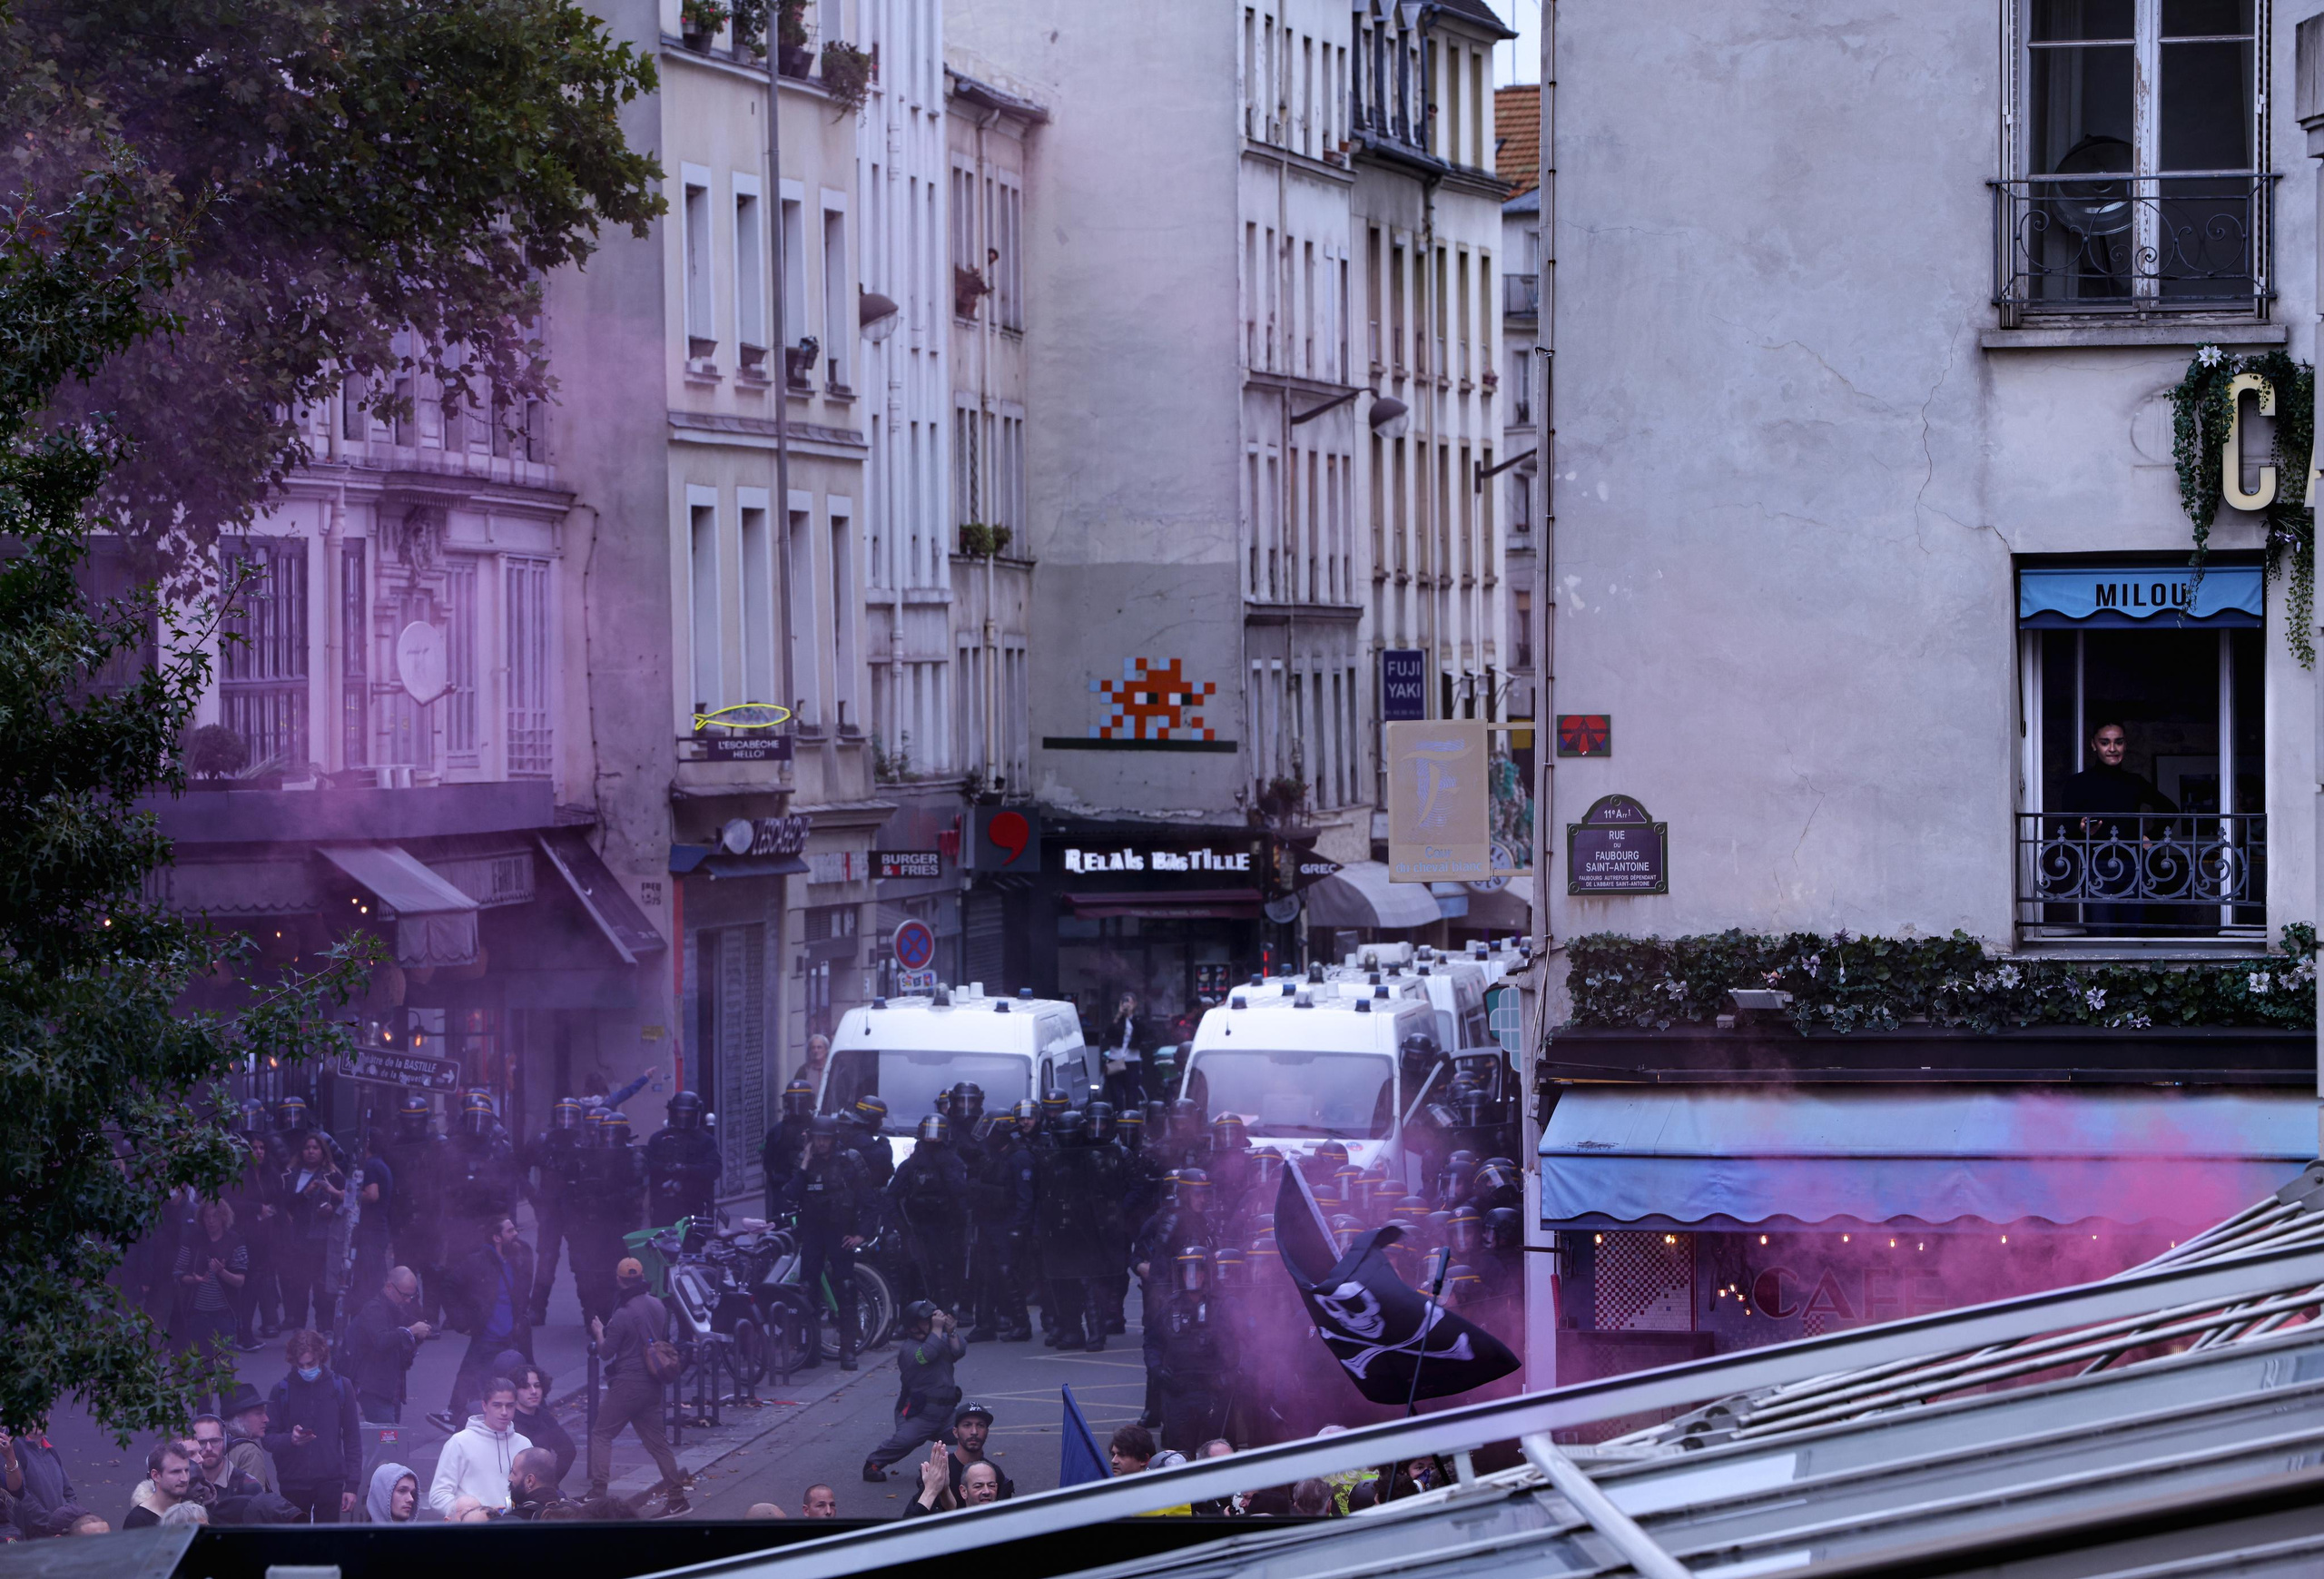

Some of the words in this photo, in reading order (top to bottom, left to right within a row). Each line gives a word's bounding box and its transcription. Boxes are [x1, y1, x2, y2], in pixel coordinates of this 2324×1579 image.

[2096, 583, 2187, 607] MILOU
[1387, 661, 1421, 676] FUJI
[1387, 683, 1421, 698] YAKI
[1609, 831, 1625, 840] RUE
[1425, 845, 1452, 860] Cour
[1595, 851, 1640, 861] FAUBOURG
[881, 854, 939, 864] BURGER
[882, 865, 893, 875] &
[901, 864, 939, 875] FRIES
[1300, 864, 1337, 874] GREC
[1395, 862, 1410, 873] du
[1413, 861, 1449, 873] cheval
[1452, 861, 1482, 873] blanc
[1586, 862, 1649, 873] SAINT-ANTOINE
[385, 1057, 393, 1068] de
[395, 1058, 402, 1070] la
[404, 1060, 438, 1073] BASTILLE
[380, 1069, 389, 1078] de
[390, 1070, 397, 1080] la
